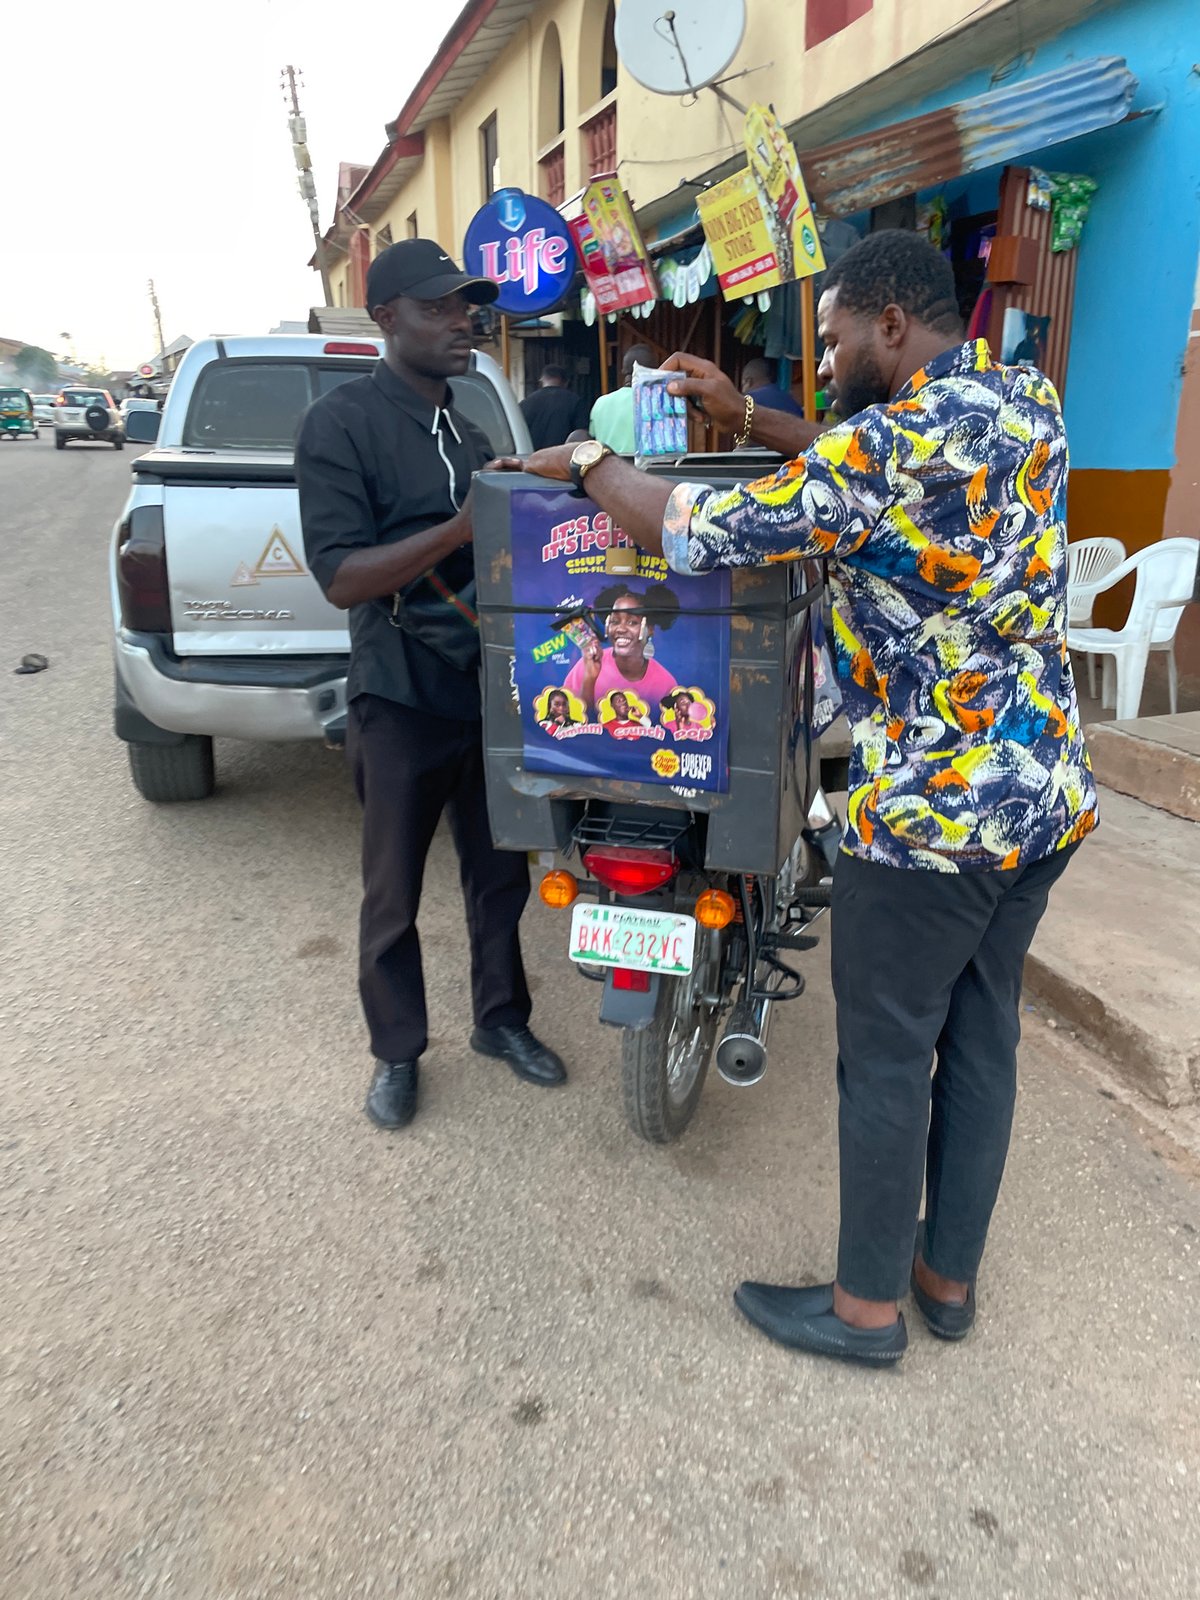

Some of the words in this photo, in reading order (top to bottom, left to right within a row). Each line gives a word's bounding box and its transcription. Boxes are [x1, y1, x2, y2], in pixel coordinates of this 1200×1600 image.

[479, 227, 569, 296] Life
[550, 515, 590, 543] IT'S
[542, 533, 579, 563] IT'S
[565, 555, 606, 568] CHUP
[636, 555, 669, 571] UPS
[567, 565, 606, 575] GUM-FIL
[183, 600, 232, 610] TOYOTA
[183, 610, 295, 621] TACOMA
[532, 633, 566, 662] NEW
[613, 725, 666, 742] crunch
[672, 728, 714, 743] pop
